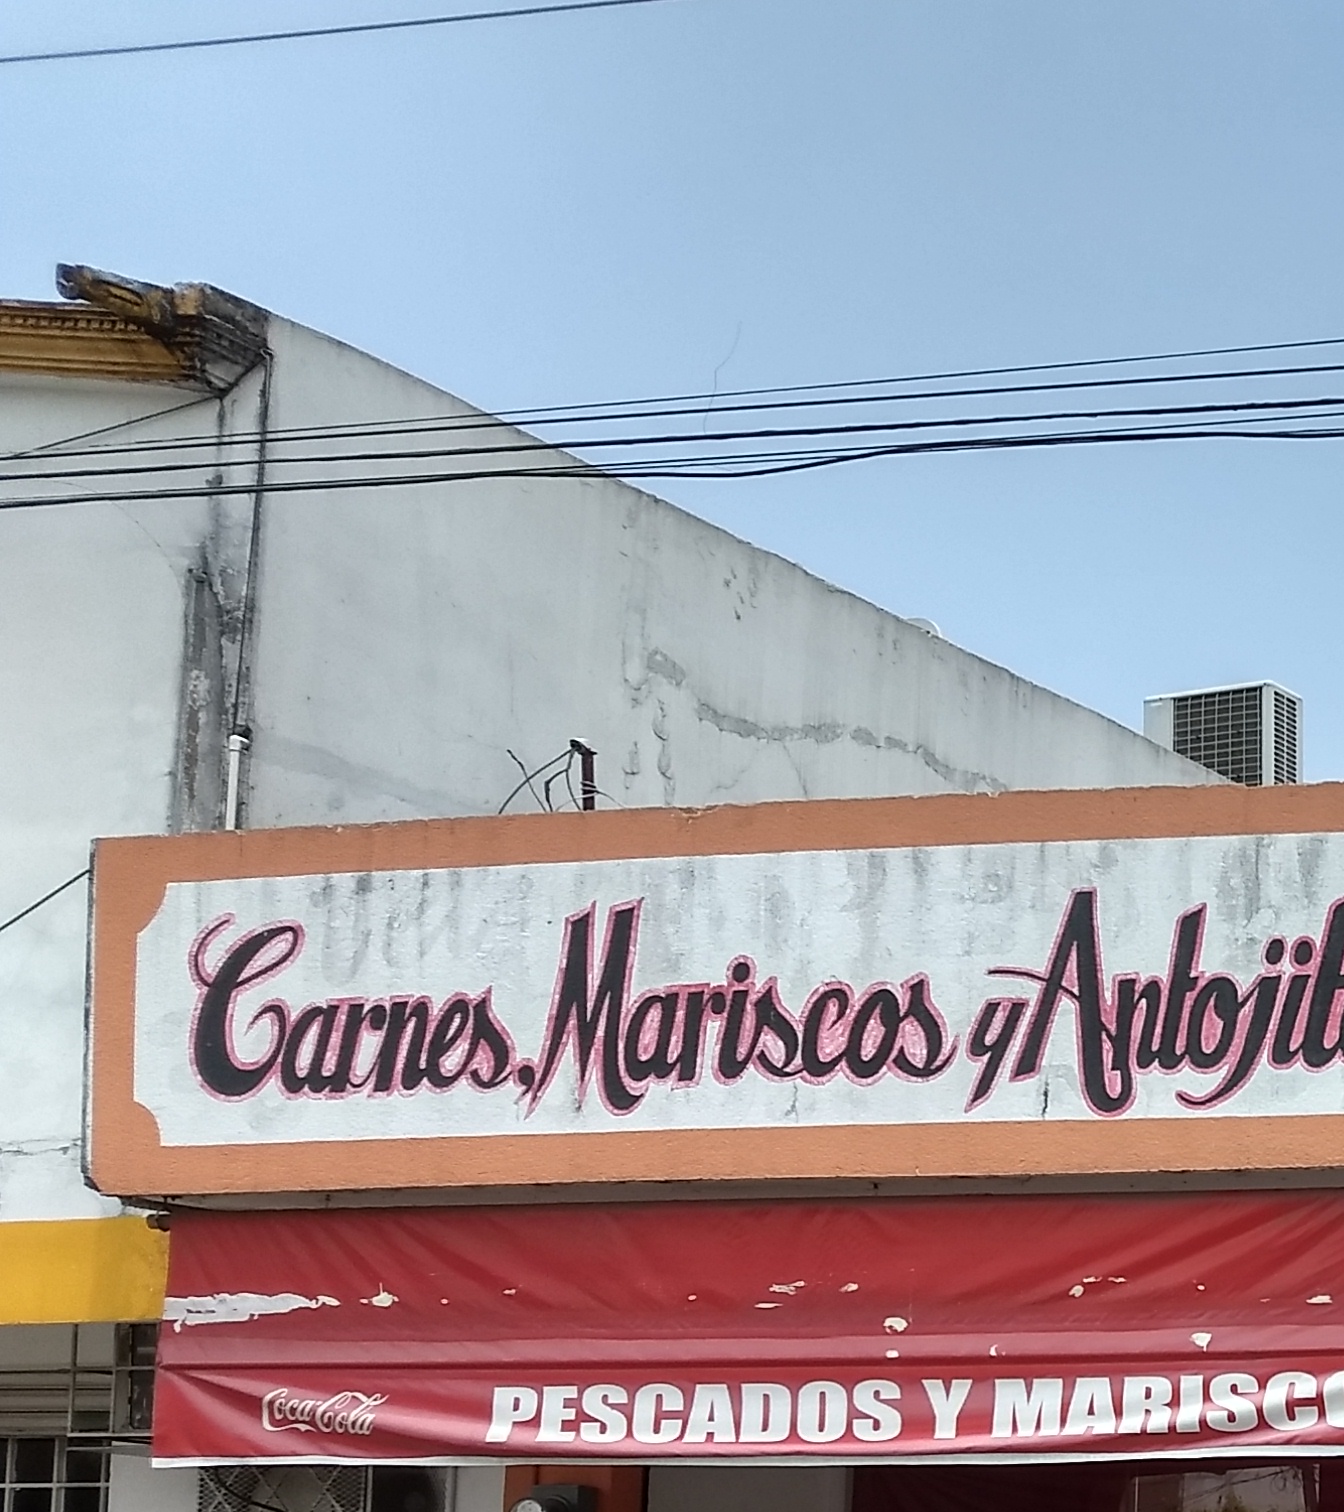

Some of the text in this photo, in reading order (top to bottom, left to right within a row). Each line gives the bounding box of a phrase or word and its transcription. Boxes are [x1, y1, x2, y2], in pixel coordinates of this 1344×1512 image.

[187, 912, 537, 1104] Carnes,
[524, 896, 960, 1121] Mariscos
[966, 997, 1027, 1112] y
[262, 1388, 390, 1436] Coca-Cola
[484, 1382, 905, 1445] PESCADOS
[926, 1377, 974, 1441] Y
